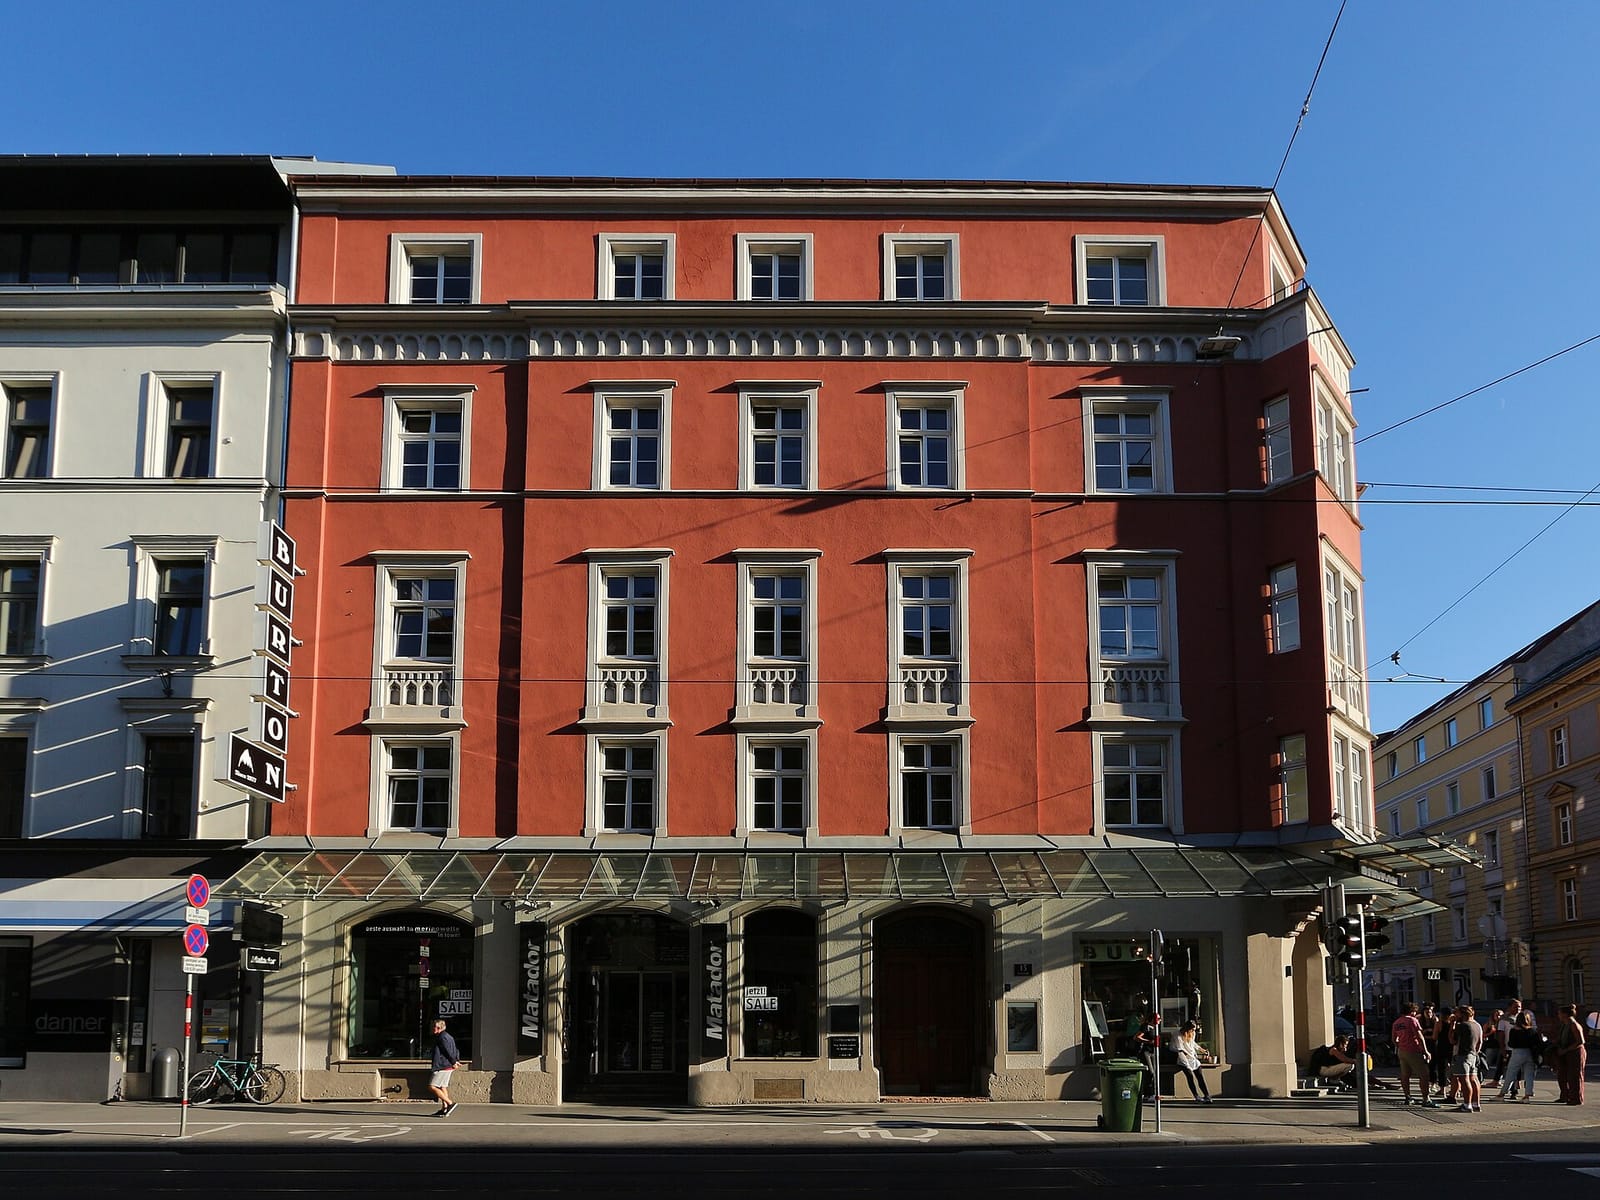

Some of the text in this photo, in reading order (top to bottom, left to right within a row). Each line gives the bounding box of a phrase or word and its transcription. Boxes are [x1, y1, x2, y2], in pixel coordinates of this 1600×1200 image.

[265, 536, 290, 789] BURTON
[441, 1002, 471, 1013] SALE
[521, 939, 543, 1039] Matador
[706, 942, 723, 1040] Matador
[746, 998, 777, 1010] SALE
[36, 1013, 105, 1033] danner
